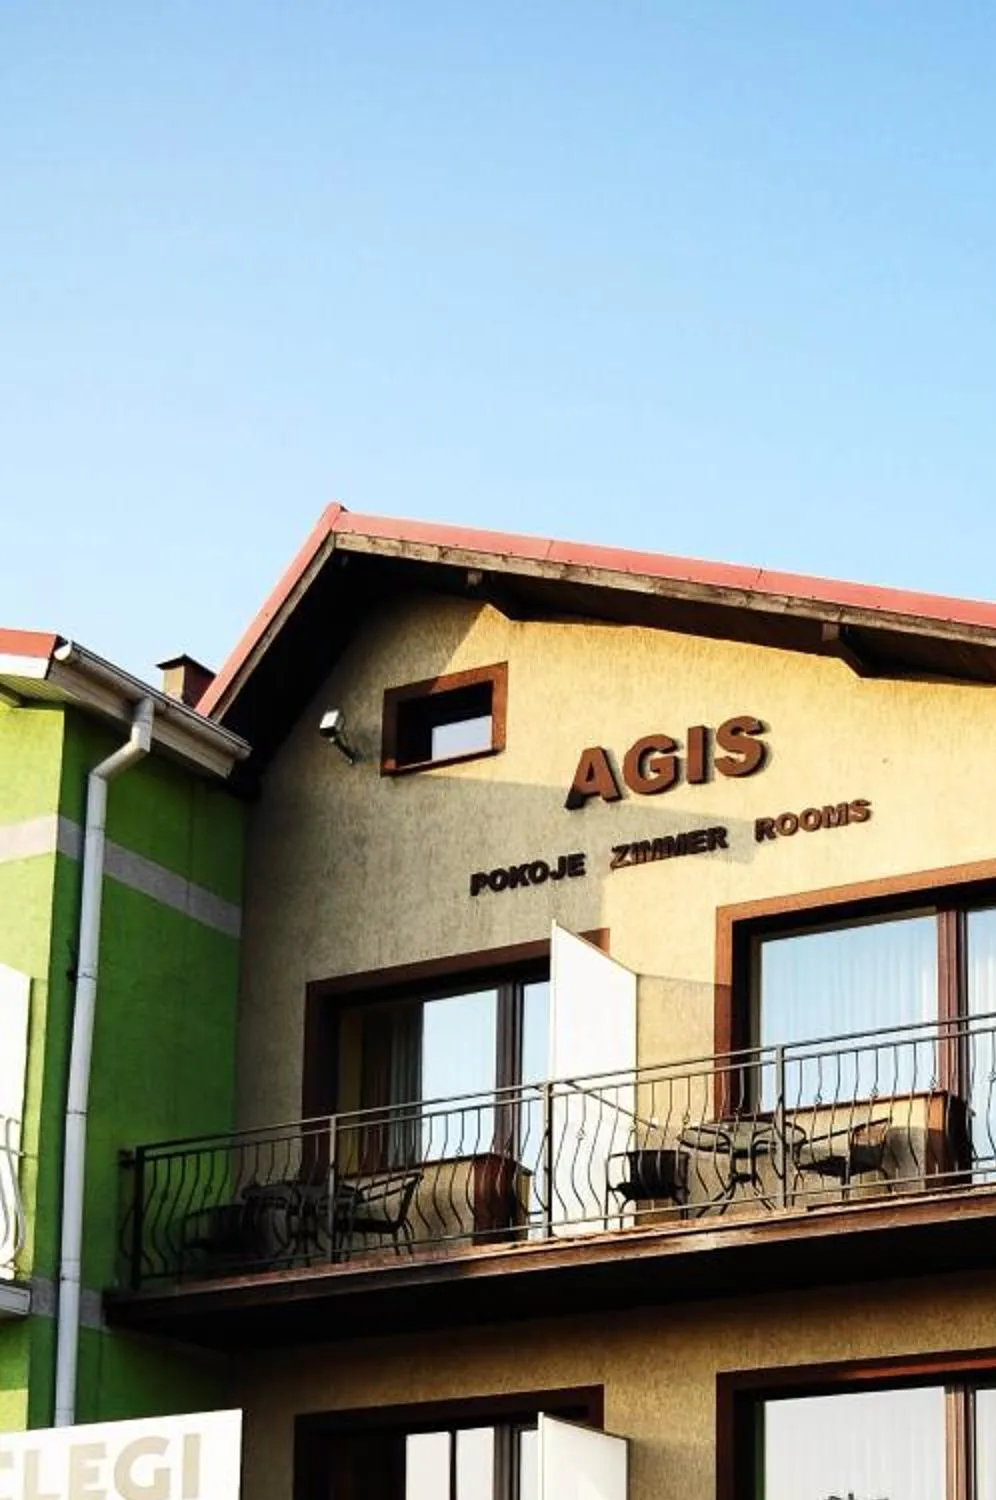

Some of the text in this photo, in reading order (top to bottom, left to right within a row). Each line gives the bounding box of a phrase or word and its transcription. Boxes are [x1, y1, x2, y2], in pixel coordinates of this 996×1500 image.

[564, 715, 769, 809] AGIS
[470, 799, 871, 896] POKOJE ZIMMER ROOMS
